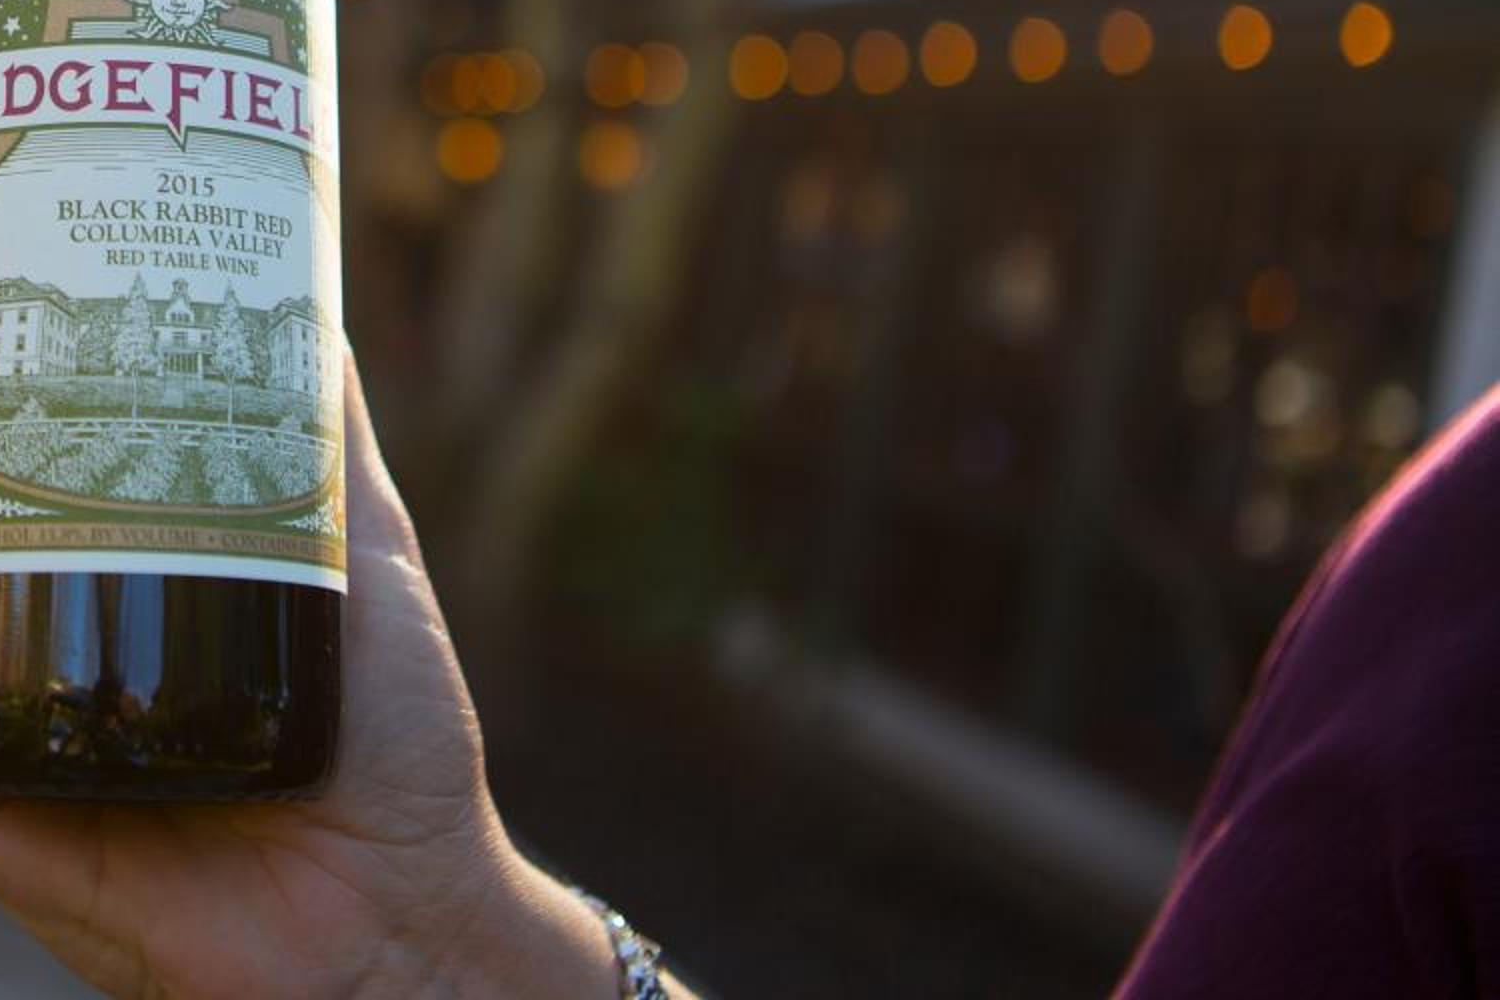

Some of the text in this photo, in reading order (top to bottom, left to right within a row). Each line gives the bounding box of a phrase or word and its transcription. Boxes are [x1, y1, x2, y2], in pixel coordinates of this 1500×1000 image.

[157, 173, 215, 197] 2015
[57, 200, 294, 239] BLACK RABBIT RED
[70, 223, 285, 259] COLUMBIA VALLEY
[106, 249, 260, 277] RED TABLE WINE
[117, 527, 198, 547] VOLUME
